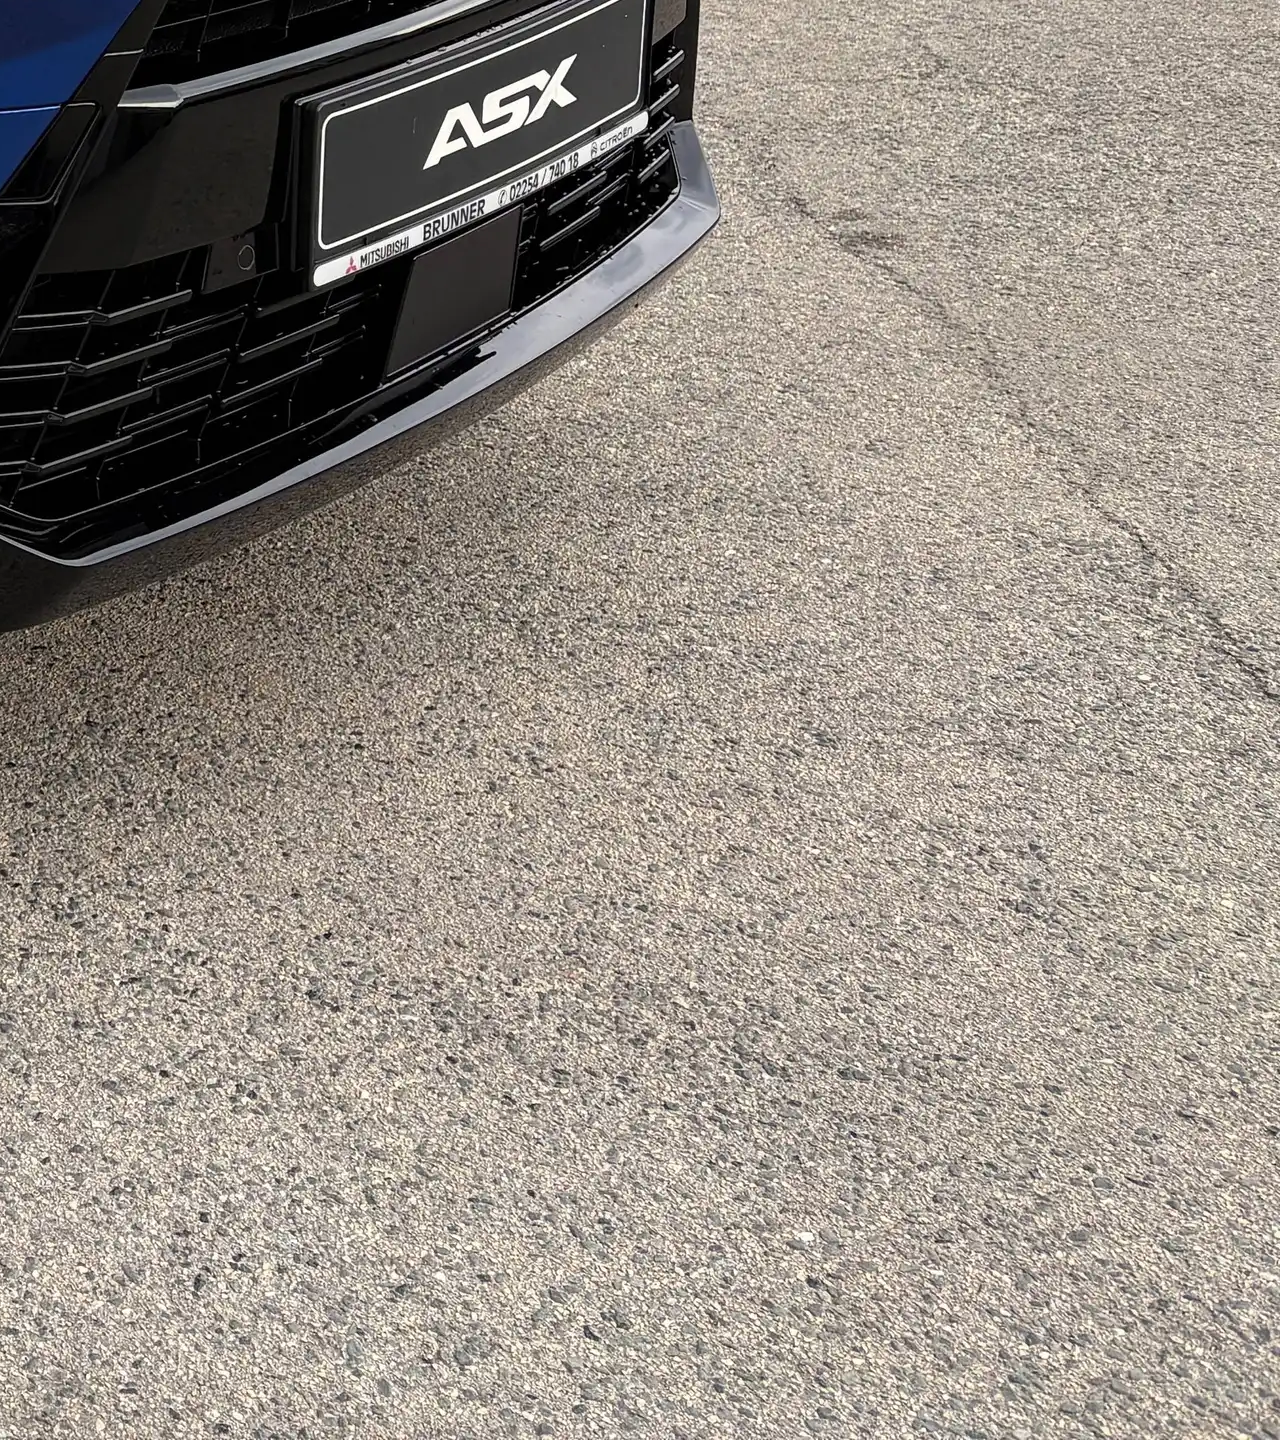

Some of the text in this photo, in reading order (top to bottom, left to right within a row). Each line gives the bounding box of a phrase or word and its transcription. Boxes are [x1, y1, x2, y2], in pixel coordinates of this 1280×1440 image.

[422, 53, 578, 170] ASX
[359, 236, 410, 269] MITSUBISHI
[422, 199, 486, 242] BRUNNER
[509, 176, 539, 202] 02254
[549, 162, 566, 183] 740
[568, 152, 579, 173] 18
